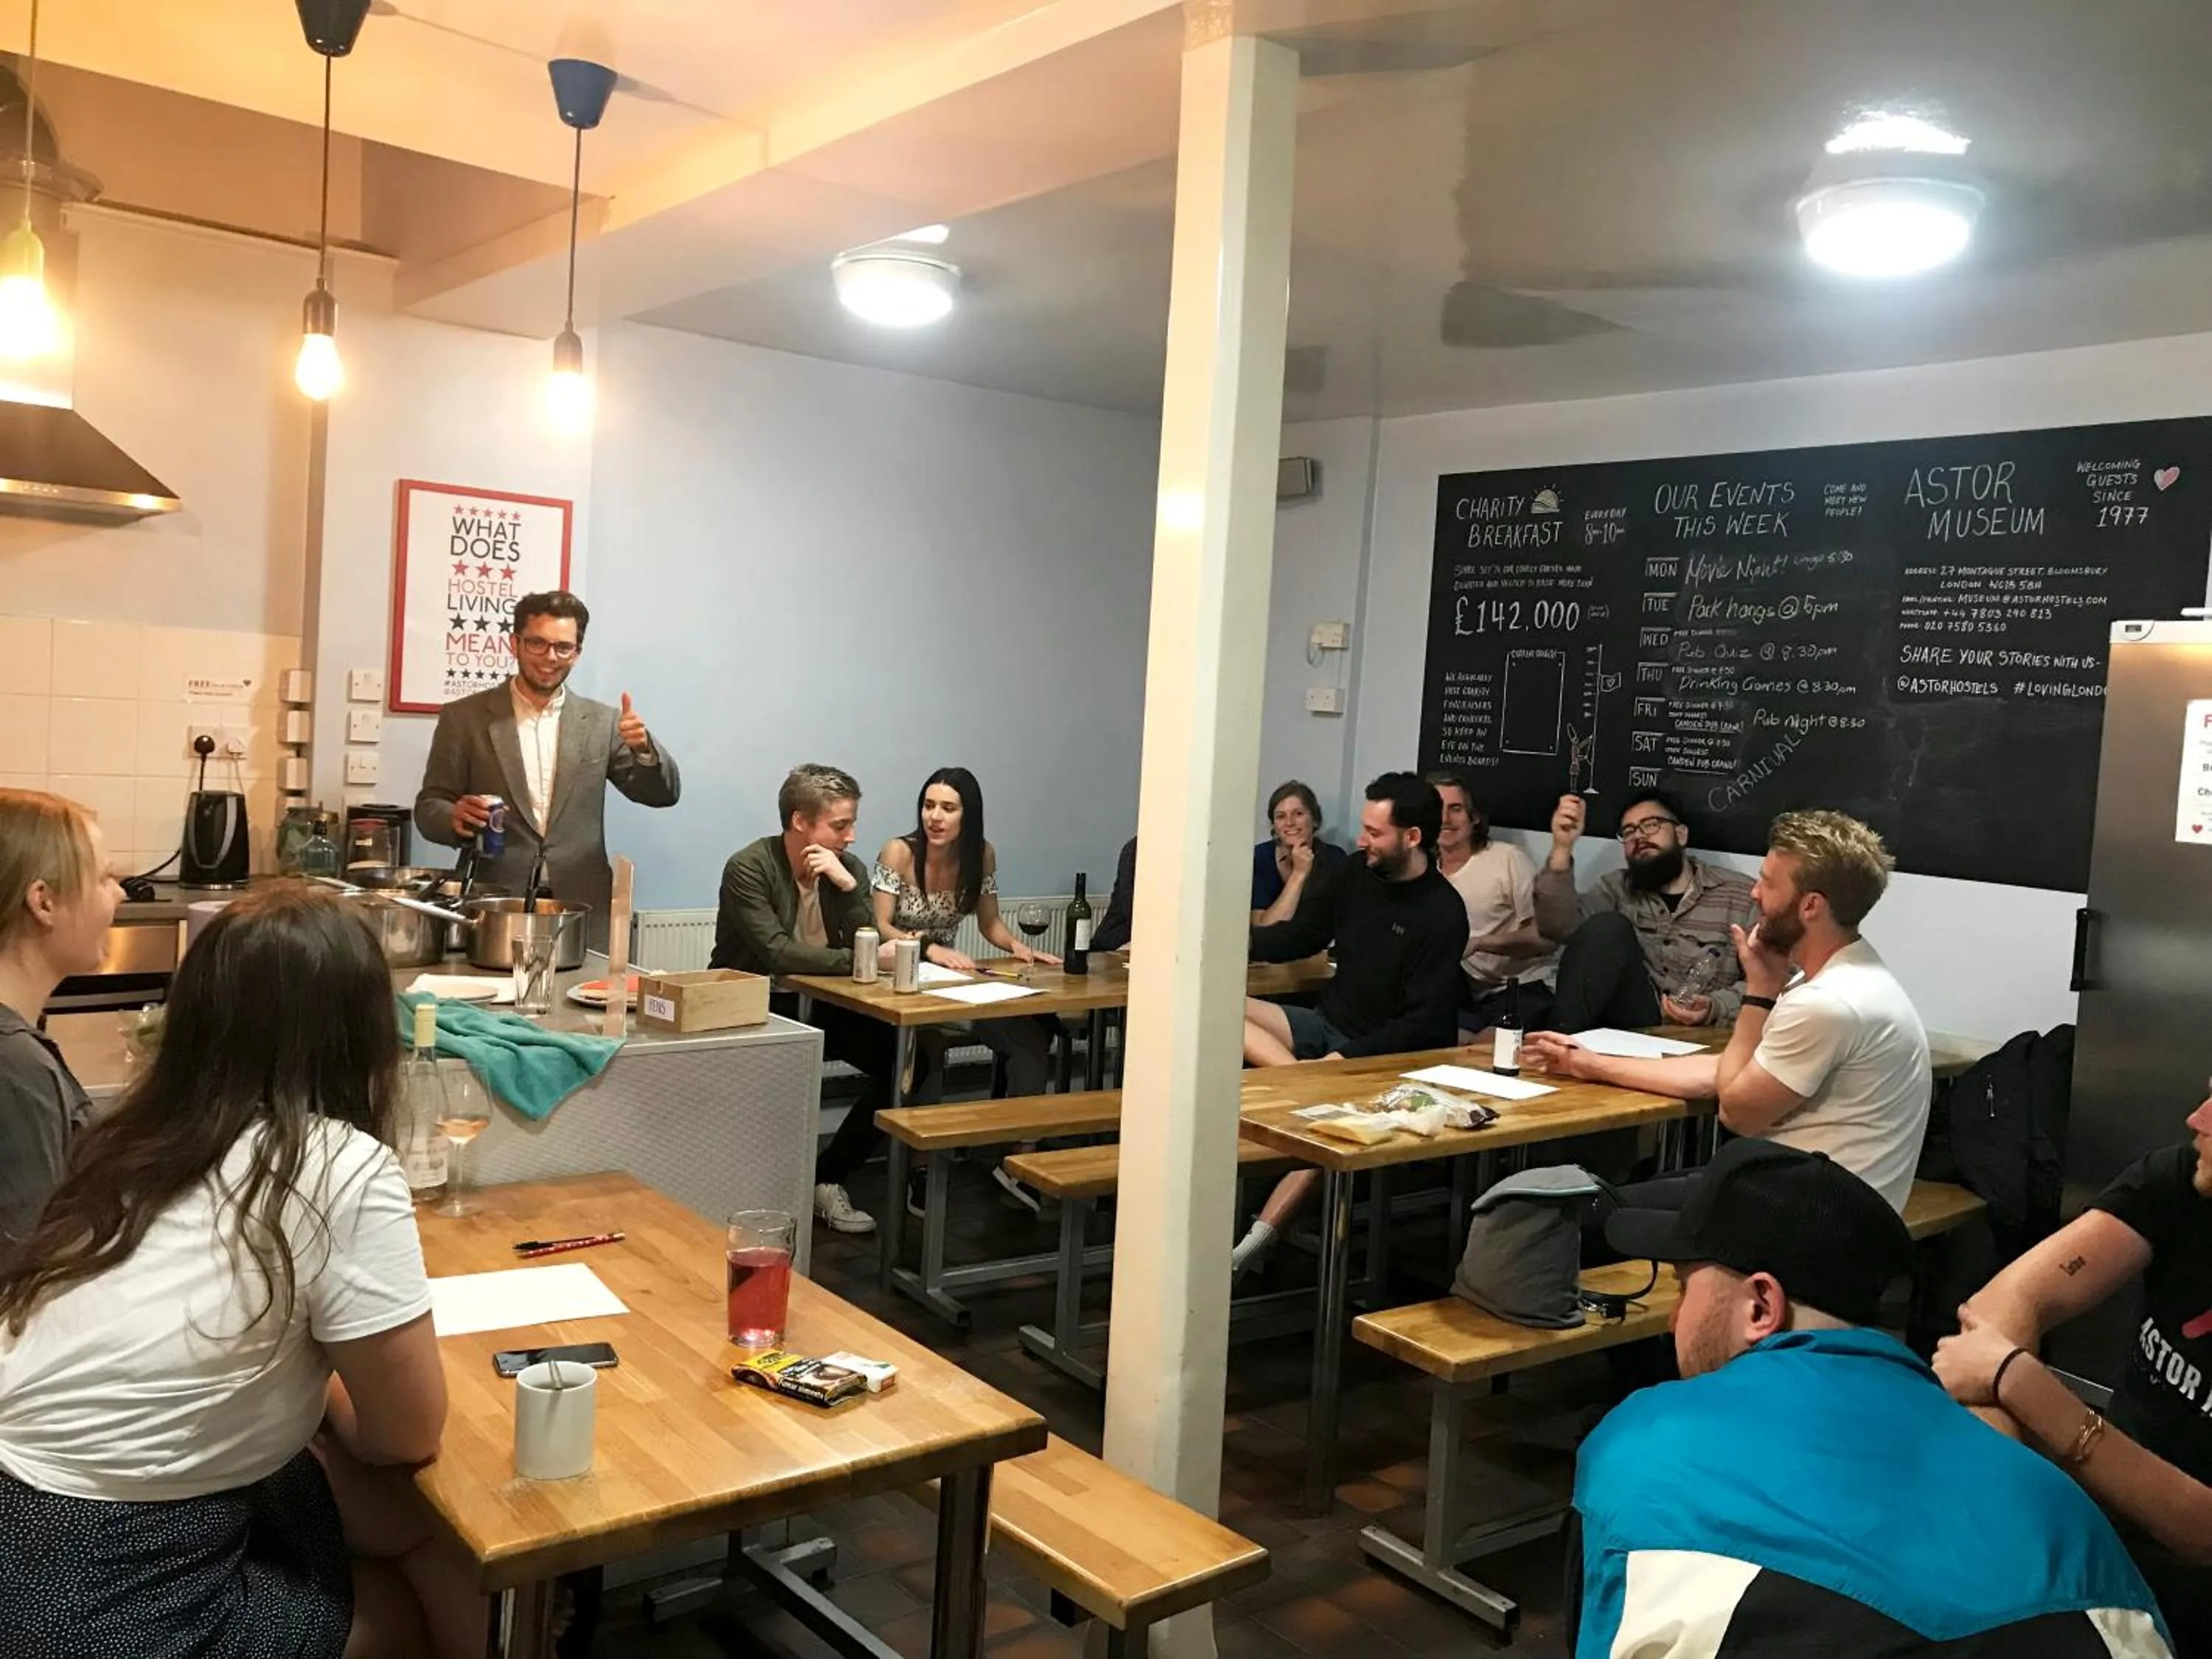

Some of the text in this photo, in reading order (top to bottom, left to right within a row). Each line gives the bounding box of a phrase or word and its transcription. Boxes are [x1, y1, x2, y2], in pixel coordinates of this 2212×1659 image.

[2076, 459, 2140, 473] WELCOMING
[1851, 483, 1867, 493] AND
[1905, 461, 2015, 507] ASTOR
[2086, 473, 2138, 488] GUESTS
[1655, 481, 1795, 514] OUR EVENTS
[2093, 490, 2132, 504] SINCE
[1456, 495, 1526, 521] CHARITY
[2096, 507, 2149, 528] 1977
[452, 515, 521, 540] WHAT
[1674, 512, 1790, 538] THIS WEEK
[1927, 507, 2045, 542] MUSEUM
[1467, 521, 1564, 549] BREAKFAST
[451, 535, 520, 562] DOES
[1649, 563, 1677, 577] MON
[1685, 554, 1733, 588] Movie
[1940, 566, 1955, 575] 27
[448, 579, 518, 597] HOSTEL
[1940, 580, 1981, 589] LONDON
[448, 594, 517, 615] LIVING
[1646, 598, 1669, 613] TUE
[1688, 594, 1723, 622] Park
[1726, 594, 1776, 625] hangs
[1455, 596, 1580, 636] £142.000
[446, 632, 514, 653] MEAN
[1642, 633, 1669, 647] WED
[446, 653, 517, 668] TO YOU?
[1677, 641, 1705, 661] Pub
[1900, 644, 1952, 667] SHARE
[1959, 649, 1994, 667] YOUR
[1999, 651, 2050, 667] STORIES
[2053, 655, 2078, 669] WITH
[1641, 667, 1663, 682] THU
[1679, 676, 1738, 695] Drinking
[1742, 676, 1791, 692] Games
[1897, 675, 1998, 695] @ASTORHOSTELS
[1638, 703, 1657, 717] FRI
[1753, 708, 1780, 726] Pub
[1635, 736, 1657, 751] SAT
[1633, 771, 1658, 788] SUN
[1708, 733, 1802, 812] CARNIVAL
[2139, 1317, 2202, 1400] ASTOR
